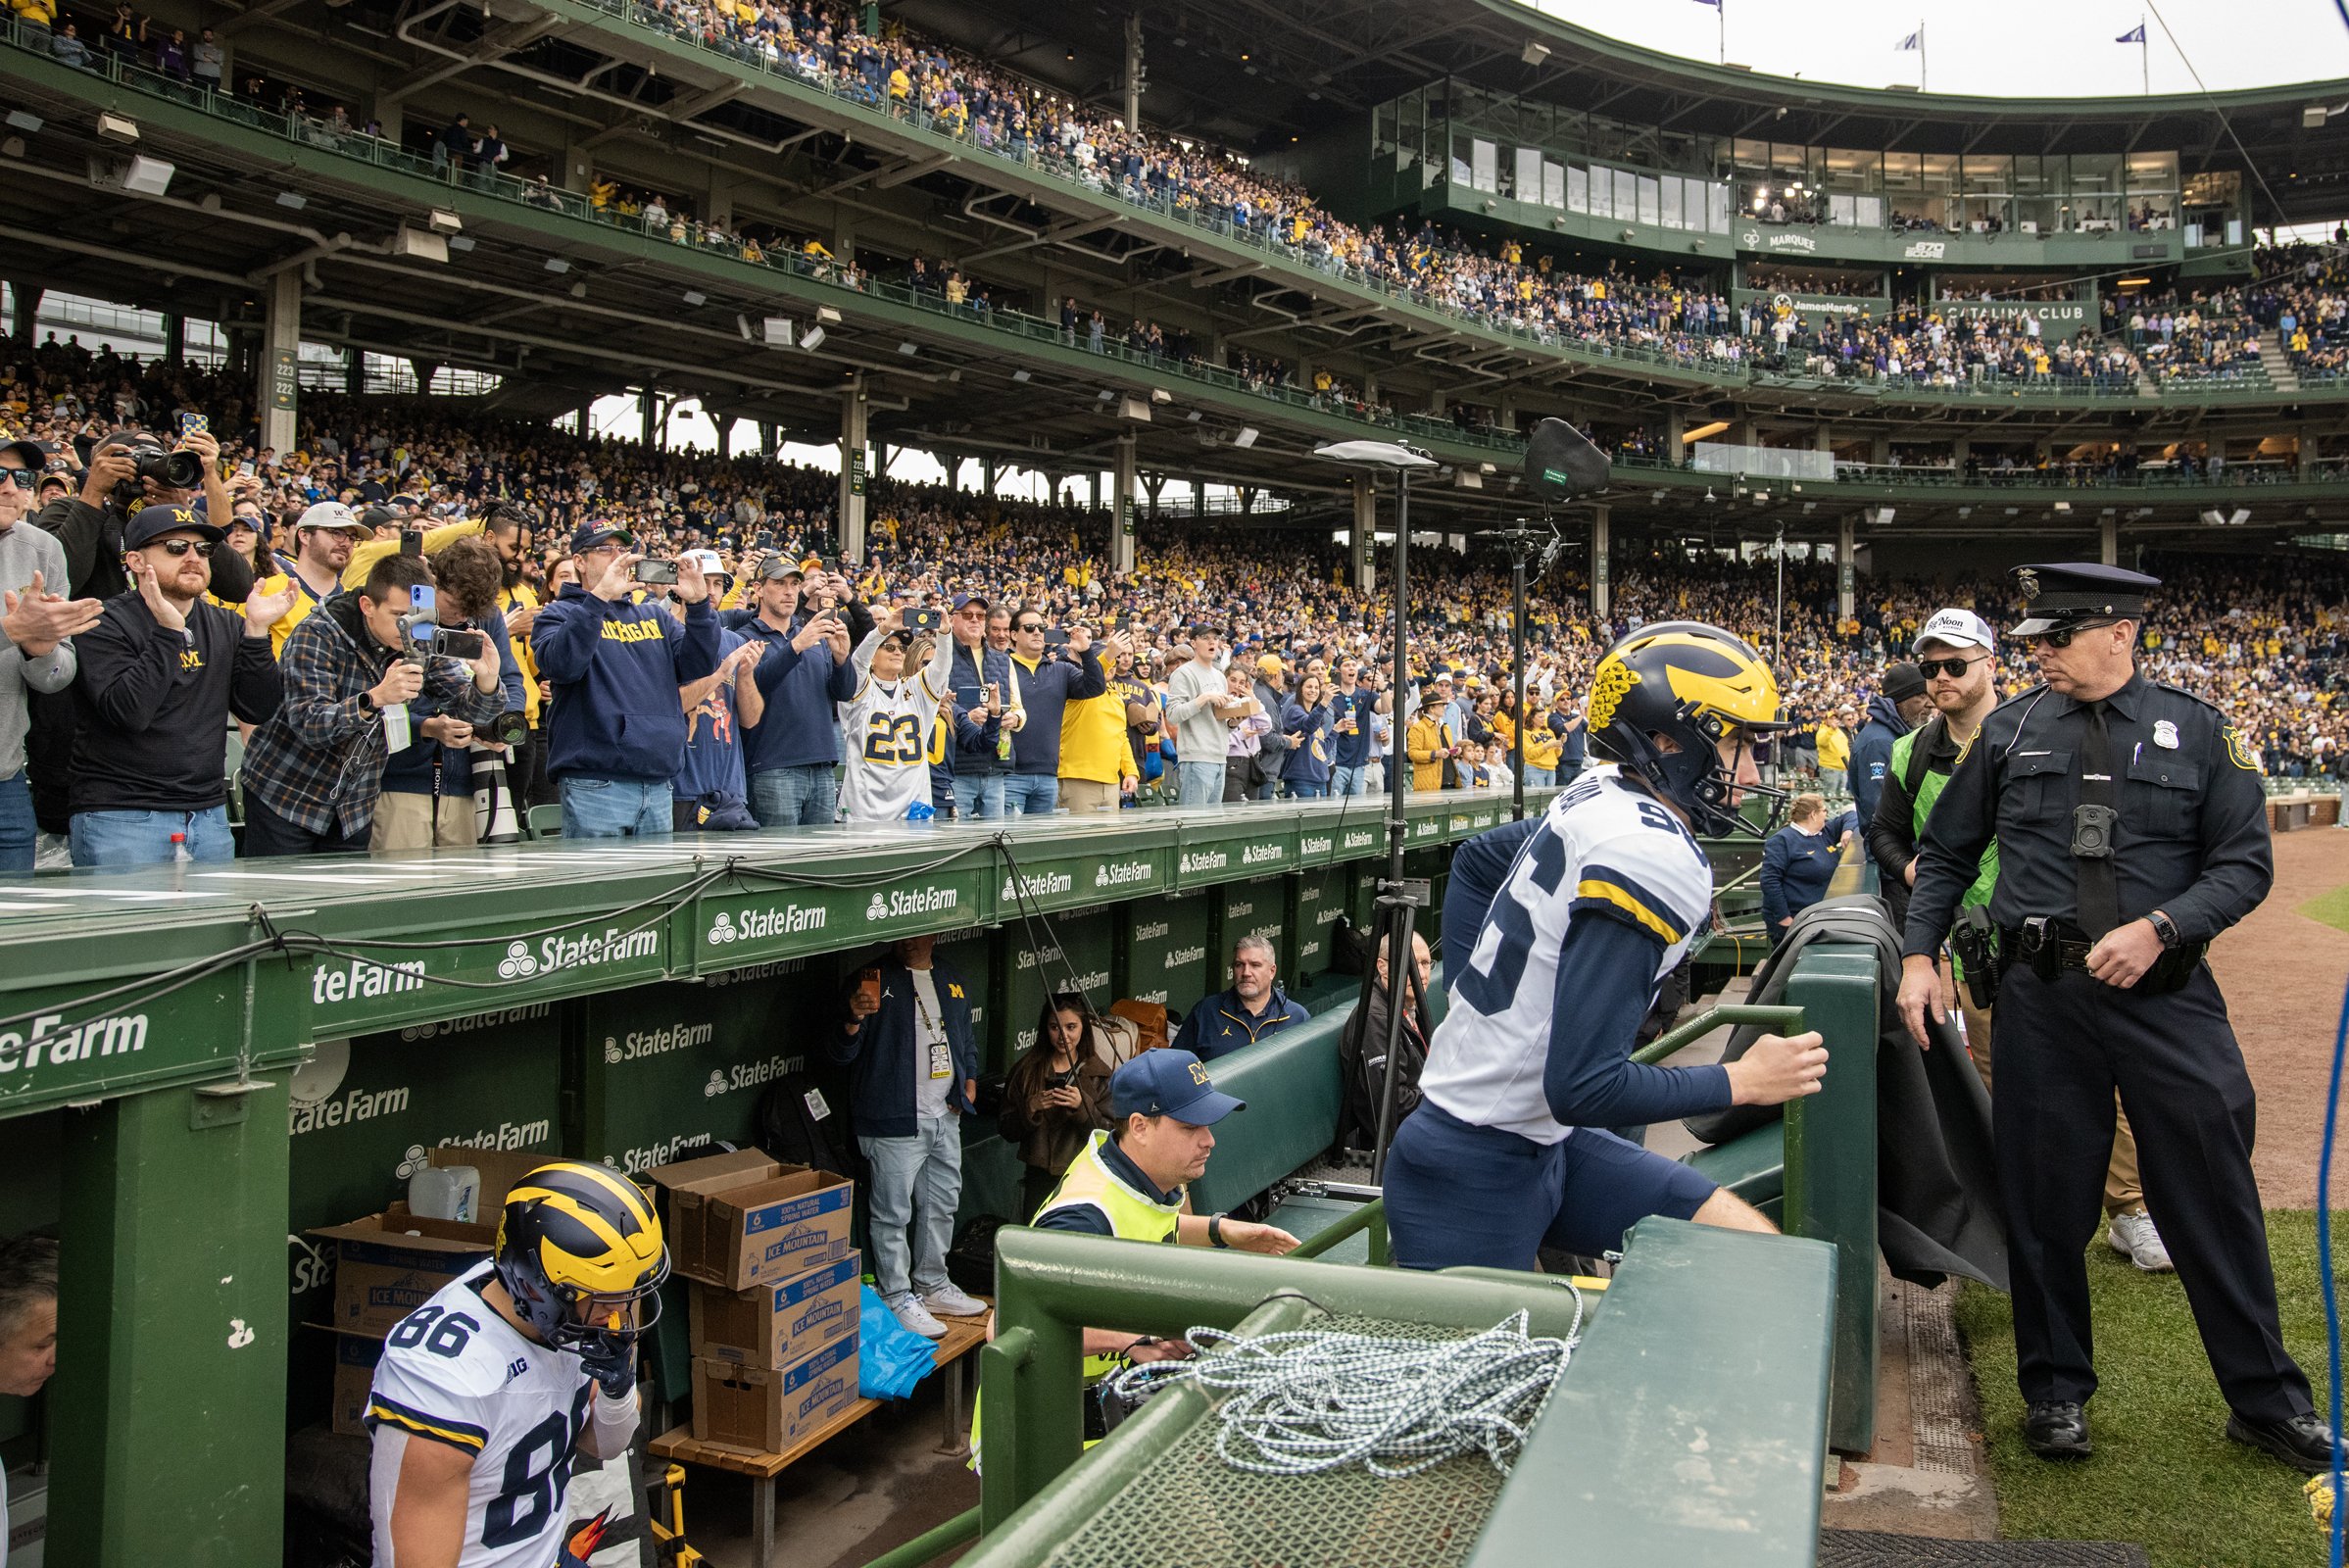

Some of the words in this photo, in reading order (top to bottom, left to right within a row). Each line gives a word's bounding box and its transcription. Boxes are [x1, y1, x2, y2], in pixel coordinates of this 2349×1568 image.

[1770, 234, 1816, 251] MARQUEE
[1916, 242, 1945, 251] 670
[1905, 250, 1944, 259] SCORE
[1794, 301, 1859, 314] JamesHardie
[2038, 307, 2083, 319] CLUB
[277, 364, 294, 376] 223
[276, 382, 293, 395] 222
[853, 460, 863, 469] 222
[853, 474, 863, 484] 221
[171, 509, 196, 522] M
[1938, 616, 1964, 627] Noon
[179, 651, 203, 668] M
[863, 711, 924, 765] 23
[1306, 836, 1332, 854] StateFarm
[1350, 831, 1373, 847] StateFarm
[1191, 851, 1227, 871] StateFarm
[1251, 844, 1283, 862] StateFarm
[1109, 861, 1151, 884] StateFarm
[1019, 872, 1071, 899] StateFarm
[889, 886, 957, 917] StateFarm
[738, 904, 826, 941] StateFarm
[1455, 821, 1567, 1017] 6
[1136, 921, 1168, 942] StateFarm
[539, 928, 658, 972] StateFarm
[1175, 946, 1205, 966] StateFarm
[313, 958, 425, 1004] teFarm
[949, 983, 964, 999] M
[0, 1013, 149, 1073] eFarm
[624, 1022, 713, 1060] StateFarm
[729, 1054, 805, 1091] StateFarm
[1188, 1061, 1210, 1086] M
[797, 1198, 821, 1211] NATURAL
[753, 1212, 761, 1226] 6
[780, 1209, 801, 1224] SPRING
[802, 1205, 820, 1218] WATER
[767, 1245, 781, 1258] ICE
[783, 1232, 826, 1255] MOUNTAIN
[371, 1291, 391, 1303] ICE
[780, 1290, 787, 1302] 6
[794, 1321, 805, 1335] ICE
[806, 1302, 841, 1326] MOUNTAIN
[388, 1305, 481, 1359] 86
[789, 1373, 796, 1386] 6
[801, 1399, 811, 1416] ICE
[811, 1381, 842, 1405] MOUNTAIN
